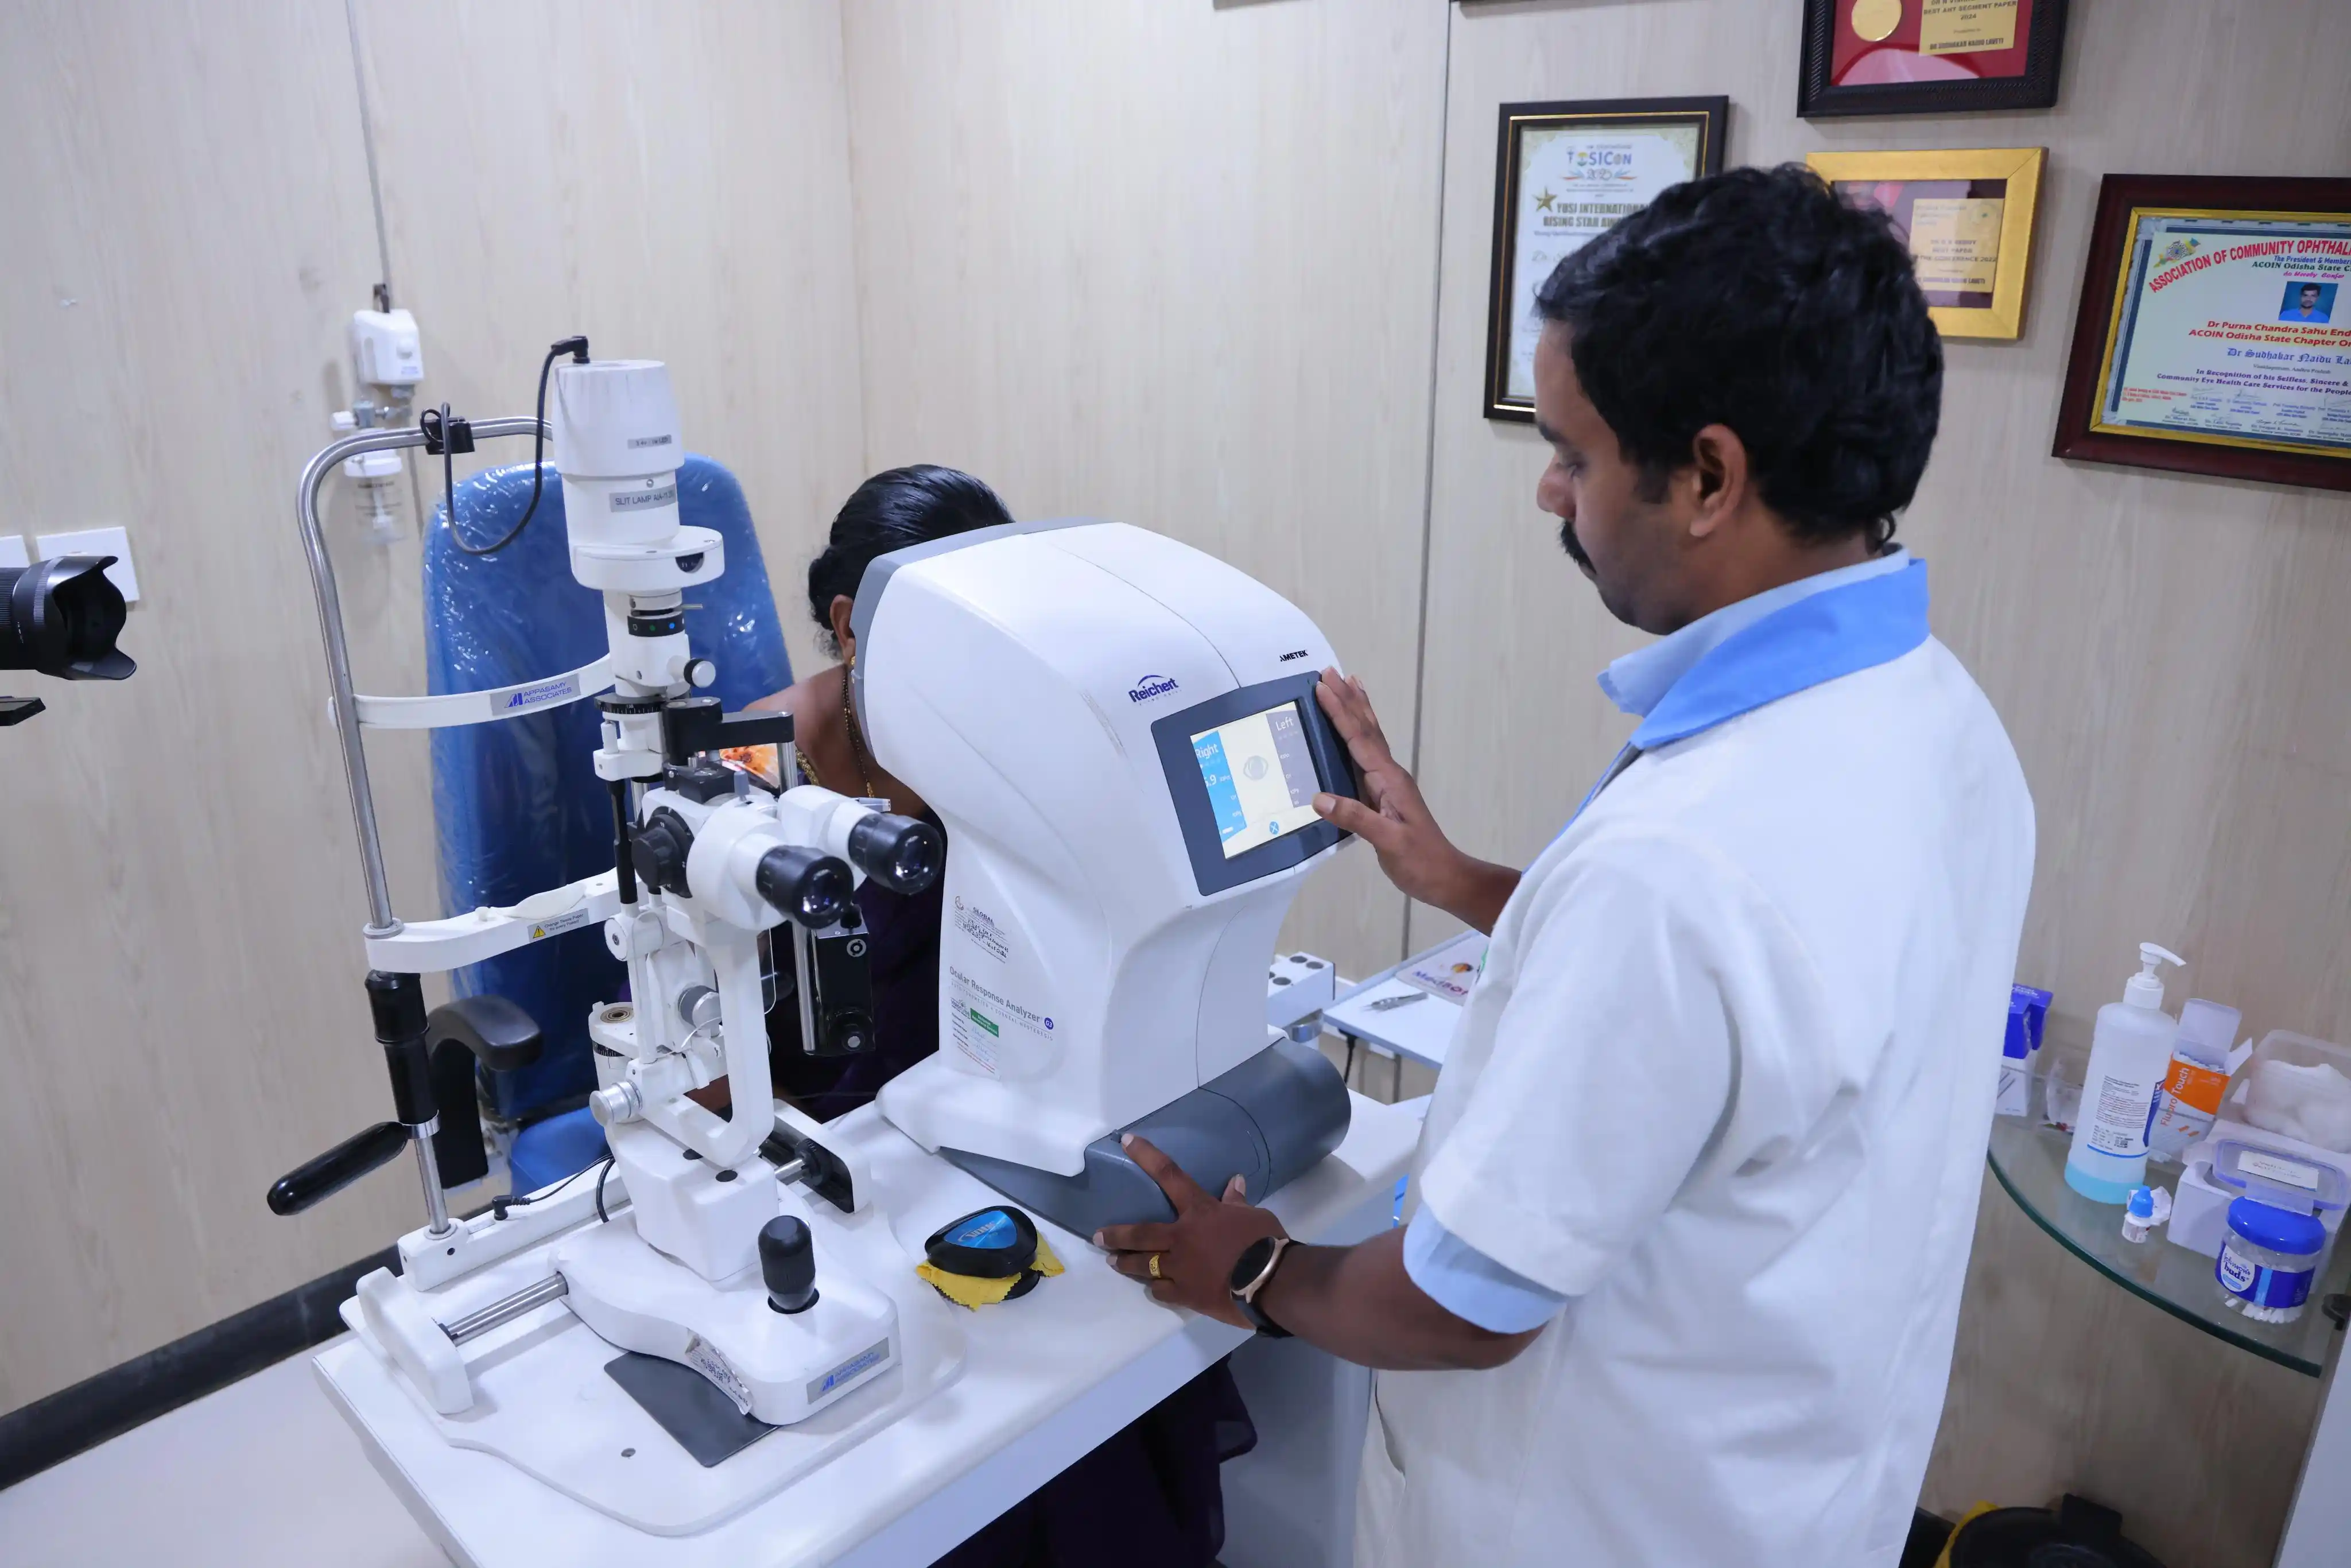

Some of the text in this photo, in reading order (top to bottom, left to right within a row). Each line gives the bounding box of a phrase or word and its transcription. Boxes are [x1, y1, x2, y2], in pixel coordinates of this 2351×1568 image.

[1543, 216, 1574, 226] RISING
[1576, 217, 1599, 227] STAR
[2149, 254, 2211, 293] ASSOCIATION
[2214, 252, 2227, 265] OF
[2230, 240, 2294, 261] COMMUNITY
[2252, 261, 2281, 269] ACOIN
[2222, 322, 2252, 331] Purna
[2255, 324, 2298, 333] Chandra
[2302, 327, 2328, 335] Sahu
[2189, 329, 2223, 338] ACOIN
[2226, 332, 2261, 341] Odisha
[2264, 335, 2291, 343] State
[2294, 337, 2337, 347] Chapter
[2227, 348, 2243, 358] Dr
[2244, 349, 2295, 362] Sudhakar
[2297, 353, 2331, 363] Naidu
[2157, 373, 2199, 383] Community
[2263, 382, 2294, 391] Services
[2325, 387, 2351, 395] People
[2206, 369, 2251, 379] Recognition
[2310, 378, 2340, 386] Sincere
[615, 497, 630, 505] SLIT
[633, 495, 651, 504] LAMP
[1279, 650, 1309, 662] AMETEK
[523, 681, 567, 696] APPASAMY
[525, 687, 572, 704] ASSOCIATES
[1128, 678, 1178, 703] Reichert
[1275, 717, 1293, 731] Left
[1195, 744, 1219, 759] Right
[950, 966, 969, 985] Ocular
[971, 979, 1004, 1005] Response
[1006, 1000, 1040, 1023] Analyzer
[963, 989, 988, 1008] TONOMETER
[995, 1009, 1018, 1024] CORNEAL
[1019, 1022, 1053, 1041] HYSTERESIS
[2171, 1068, 2190, 1094] Touch
[2224, 1263, 2245, 1282] buds
